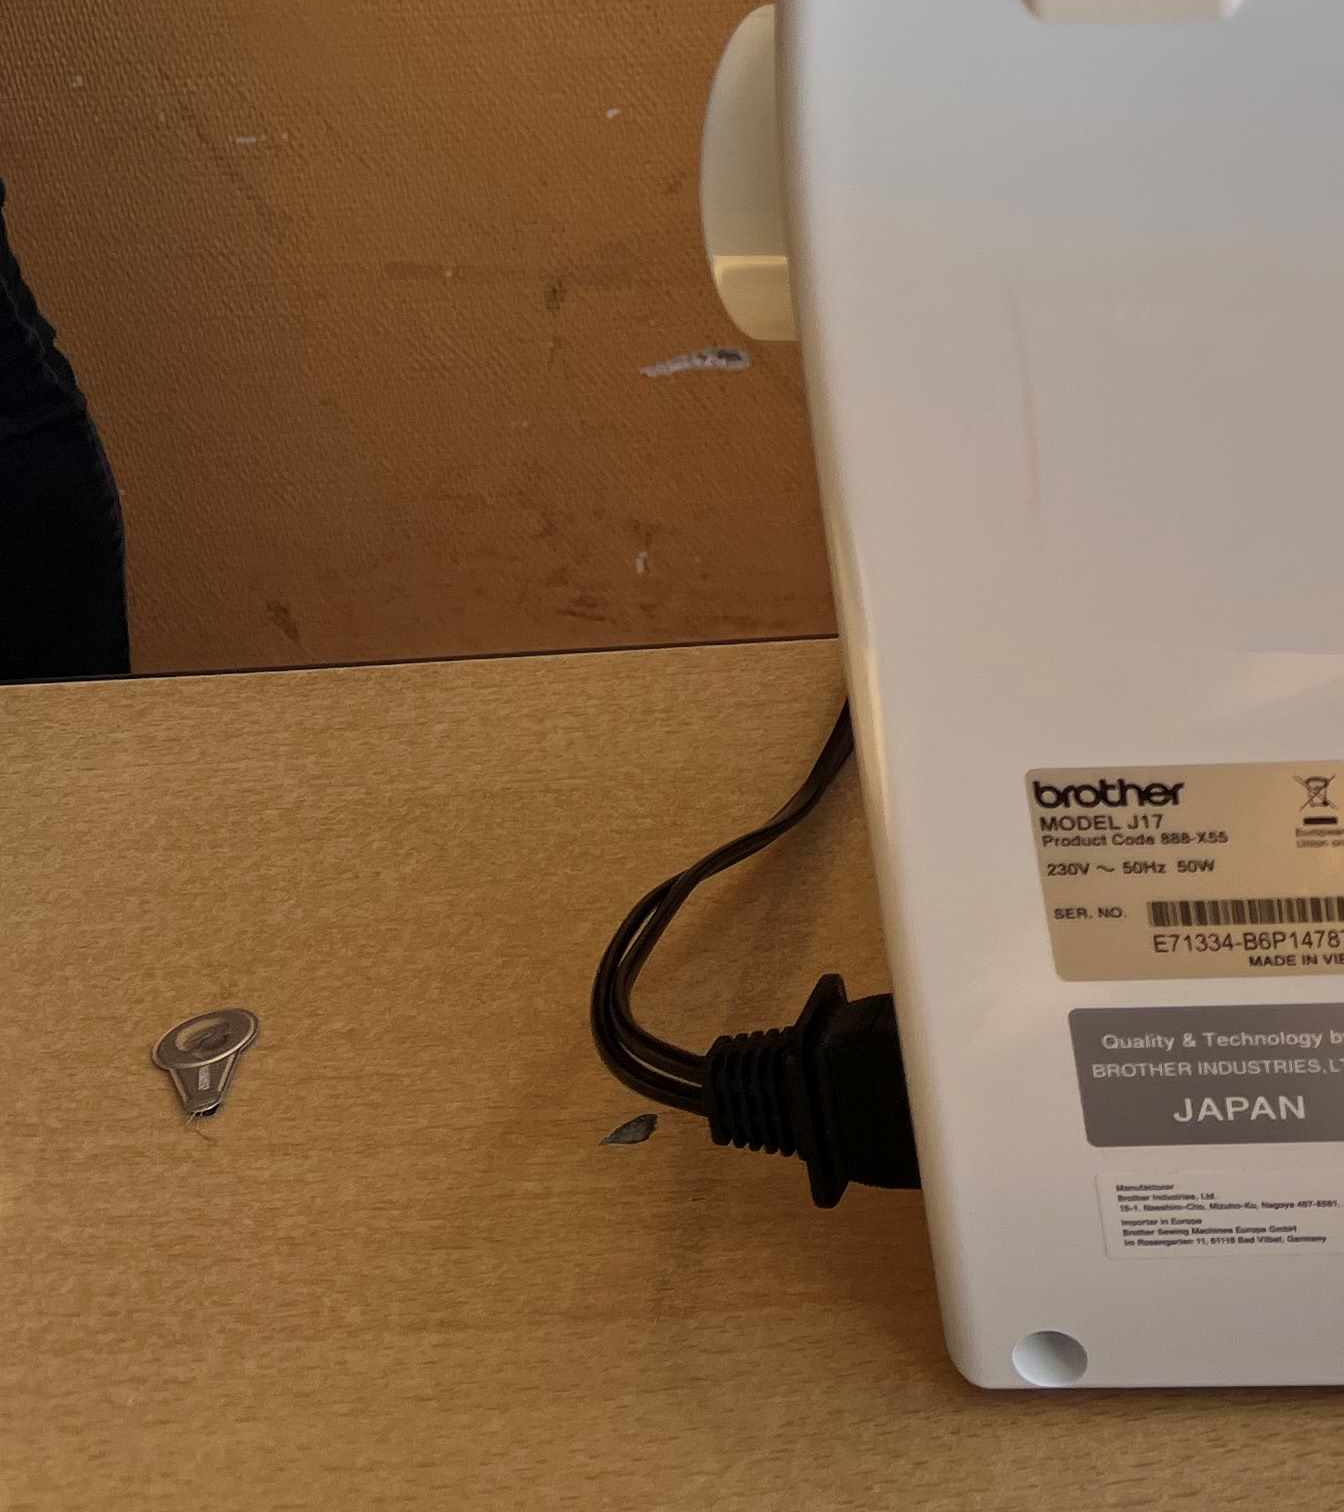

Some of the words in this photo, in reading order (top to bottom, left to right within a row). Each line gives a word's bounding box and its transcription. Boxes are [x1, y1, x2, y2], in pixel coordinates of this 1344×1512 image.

[1033, 778, 1185, 809] brother
[1040, 815, 1121, 832] MODEL
[1127, 814, 1163, 830] J17
[1042, 835, 1107, 848] Product
[1112, 833, 1155, 846] Code
[1047, 862, 1090, 877] 230V
[1122, 861, 1167, 875] 50Hz
[1177, 859, 1215, 874] 50W
[1053, 907, 1093, 920] SER.
[1098, 906, 1127, 919] NO.
[1248, 954, 1297, 968] MADE
[1302, 954, 1318, 966] IN
[1101, 1033, 1175, 1051] Quality
[1182, 1032, 1196, 1048] &
[1201, 1031, 1322, 1049] Technology
[1092, 1062, 1192, 1079] BROTHER
[1173, 1095, 1306, 1122] JAPAN
